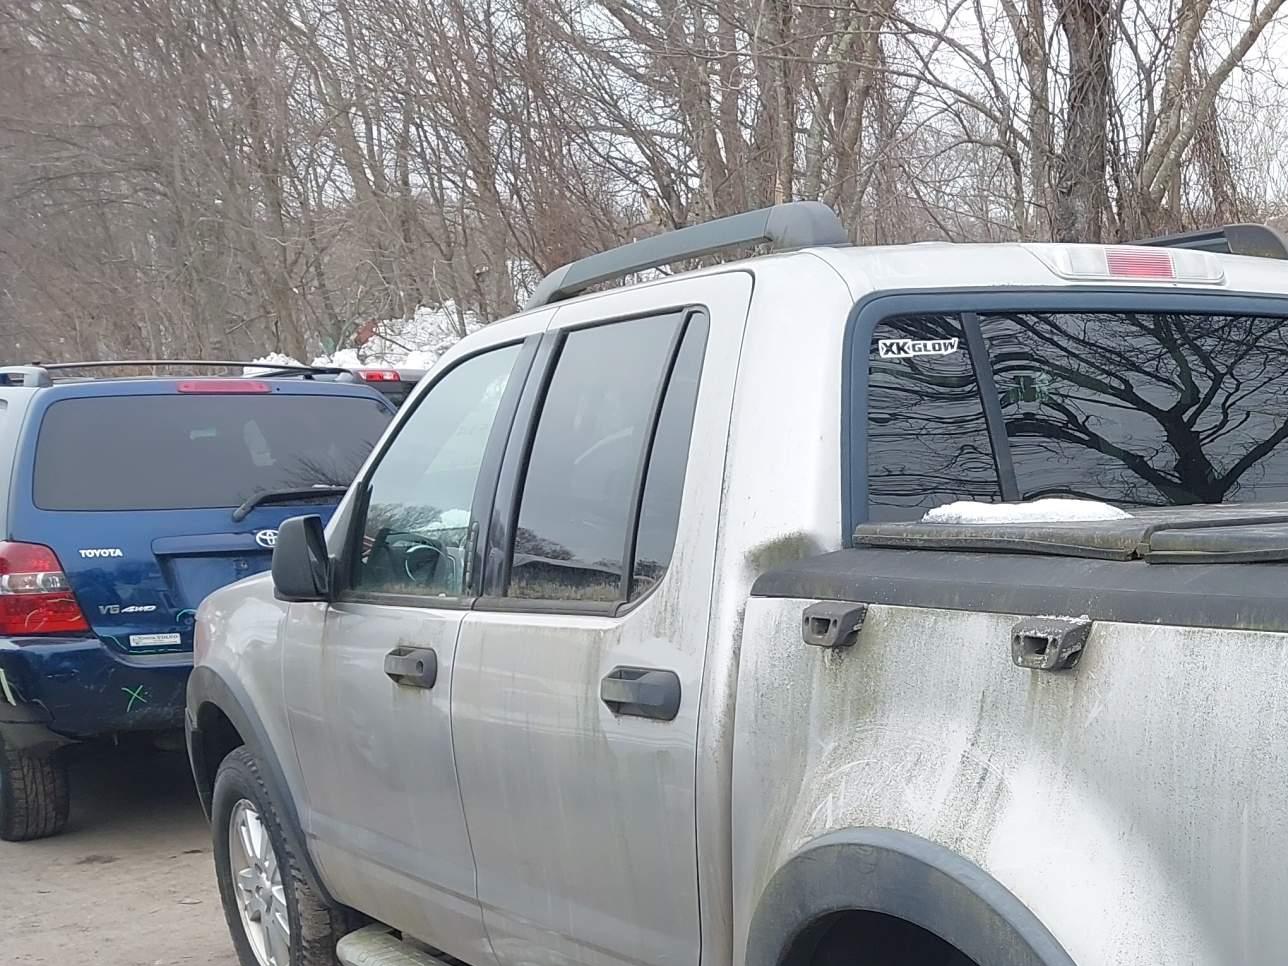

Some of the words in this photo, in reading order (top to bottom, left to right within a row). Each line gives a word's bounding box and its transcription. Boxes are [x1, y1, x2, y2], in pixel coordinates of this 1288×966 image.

[79, 549, 123, 558] TOYOTA
[98, 605, 120, 615] V6
[121, 605, 157, 614] 4WD
